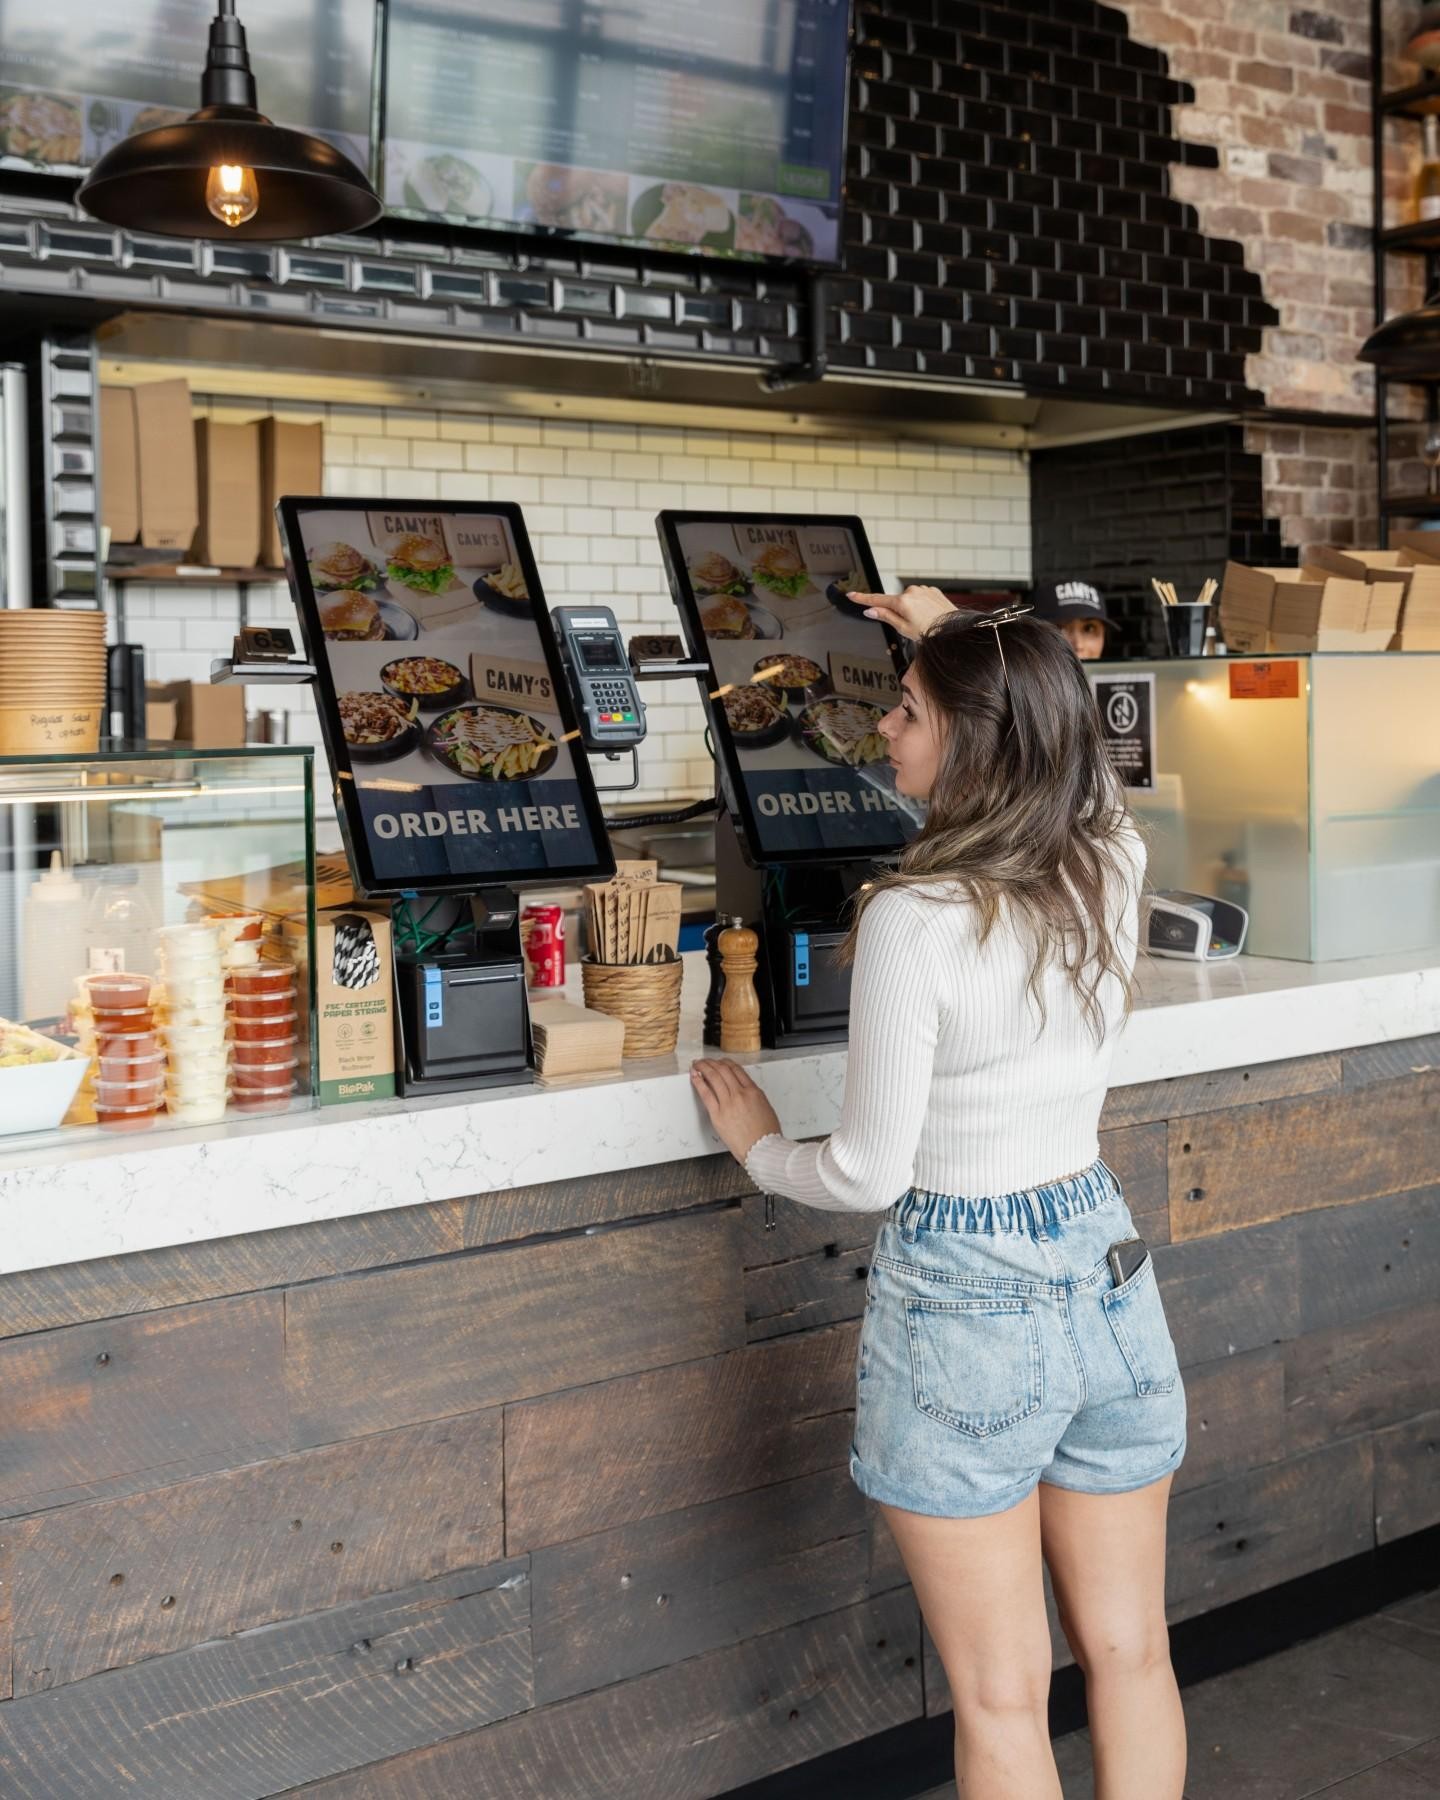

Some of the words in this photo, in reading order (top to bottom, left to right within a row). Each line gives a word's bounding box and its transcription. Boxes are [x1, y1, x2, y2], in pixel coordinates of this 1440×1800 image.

[384, 515, 441, 535] CAMY'S
[457, 533, 500, 546] CAMY'S
[647, 639, 676, 655] 37
[486, 669, 551, 698] CAMY'S
[842, 665, 898, 692] CAMY'S
[757, 791, 856, 817] ORDER
[373, 809, 492, 839] ORDER
[497, 804, 581, 833] HERE
[323, 1009, 353, 1018] PAPER
[354, 1006, 387, 1016] STRAWS
[338, 1081, 375, 1095] BioPak
